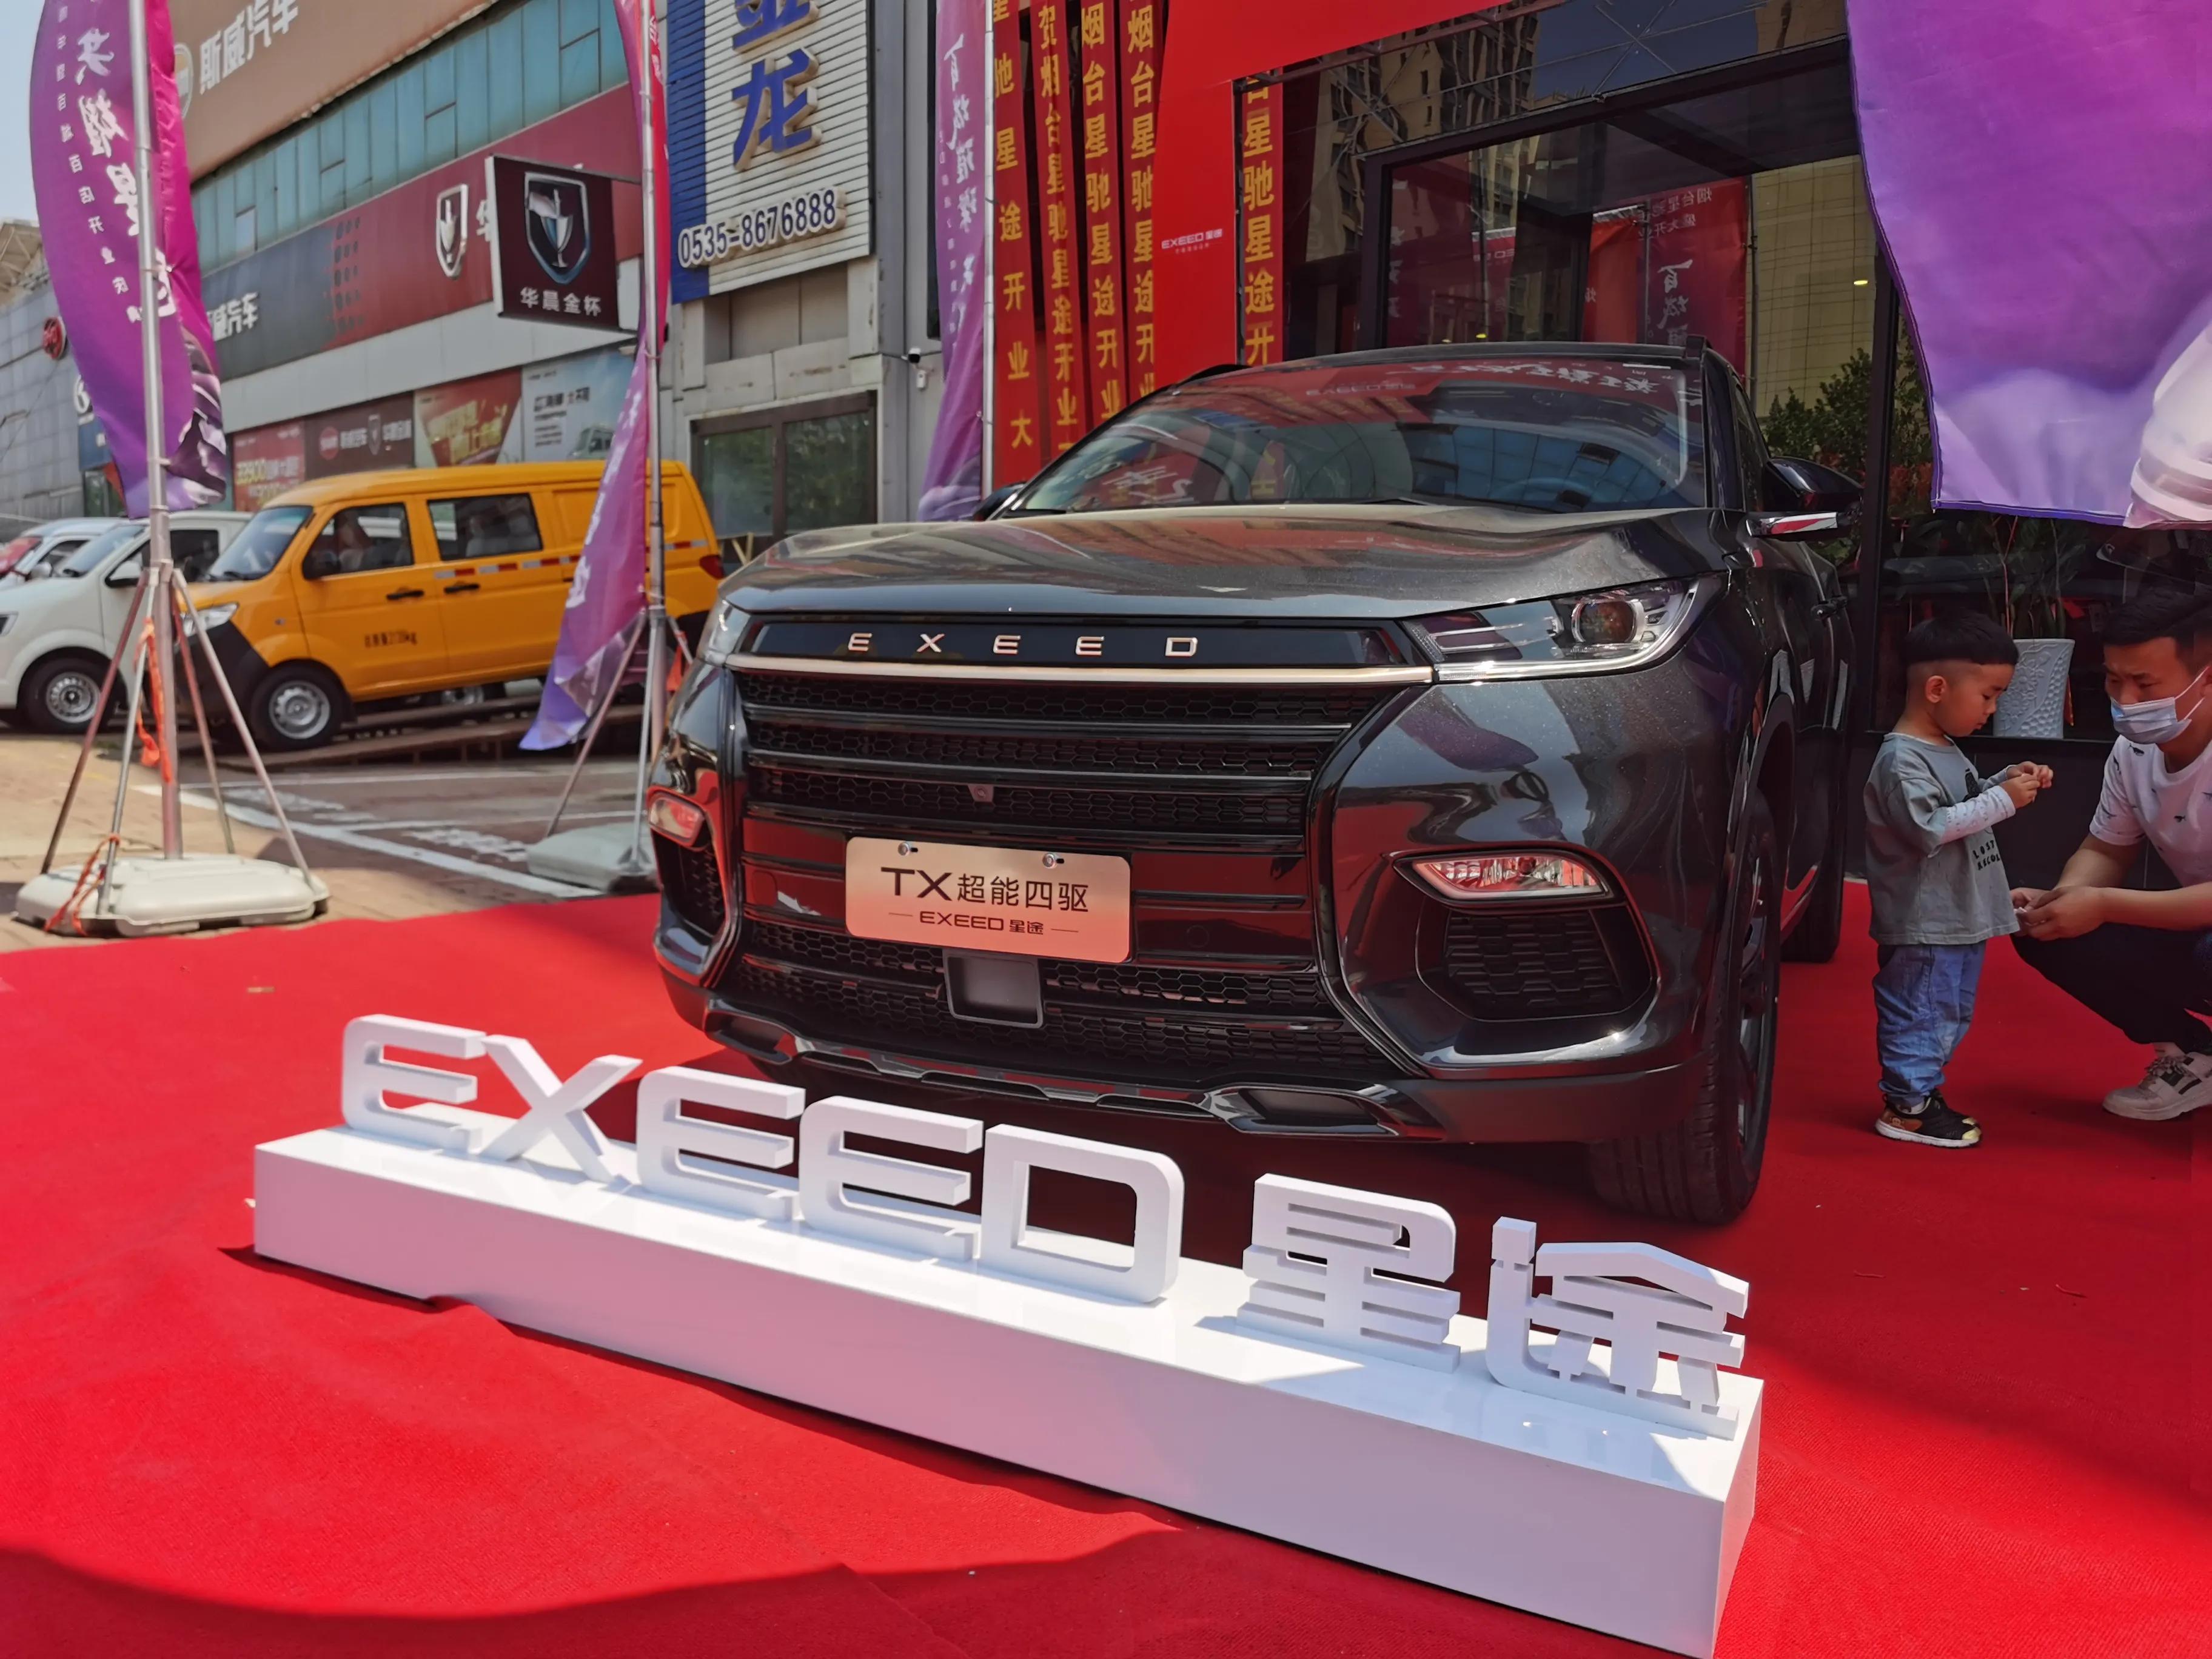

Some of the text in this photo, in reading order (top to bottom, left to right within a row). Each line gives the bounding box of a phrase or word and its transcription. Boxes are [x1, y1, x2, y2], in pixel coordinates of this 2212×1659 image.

[199, 0, 298, 95] 斯威汽车
[680, 189, 837, 265] 0535-8676888
[1037, 5, 1078, 450] 贺烟台星驰星途开业
[1161, 233, 1204, 249] EXEED
[520, 286, 602, 317] 华晨金杯
[848, 632, 1198, 657] EXEED
[1972, 840, 1994, 859] LOST
[919, 911, 1044, 935] EXEED 星途
[340, 1014, 1750, 1441] EXEED 星途
